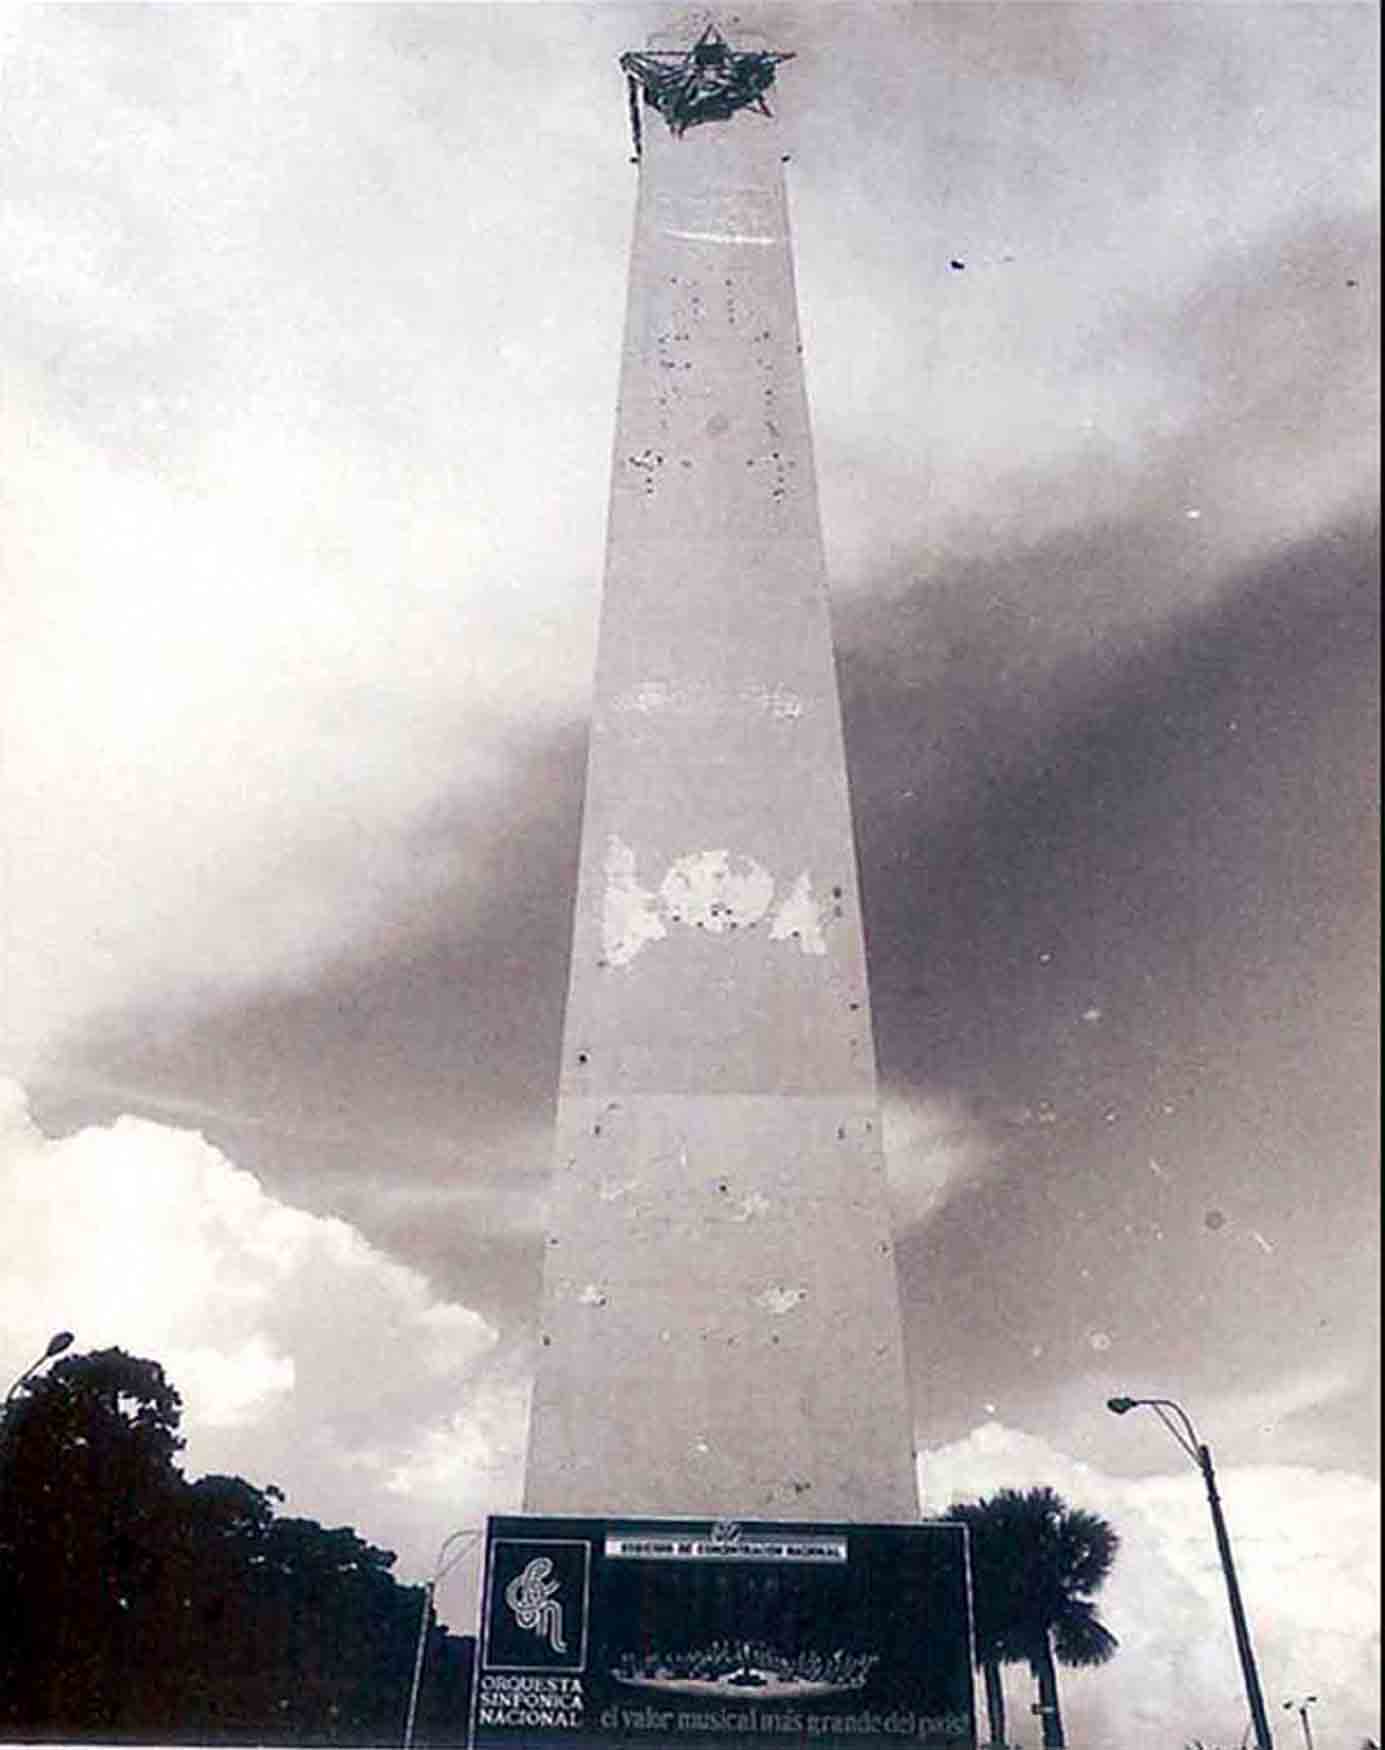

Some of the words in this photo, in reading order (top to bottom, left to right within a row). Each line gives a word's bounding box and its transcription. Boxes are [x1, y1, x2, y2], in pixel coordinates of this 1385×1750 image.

[481, 1676, 583, 1693] ORQUESTA
[479, 1709, 583, 1728] NACIONAL
[600, 1706, 618, 1728] el
[621, 1706, 674, 1729] valor
[678, 1707, 757, 1731] musical
